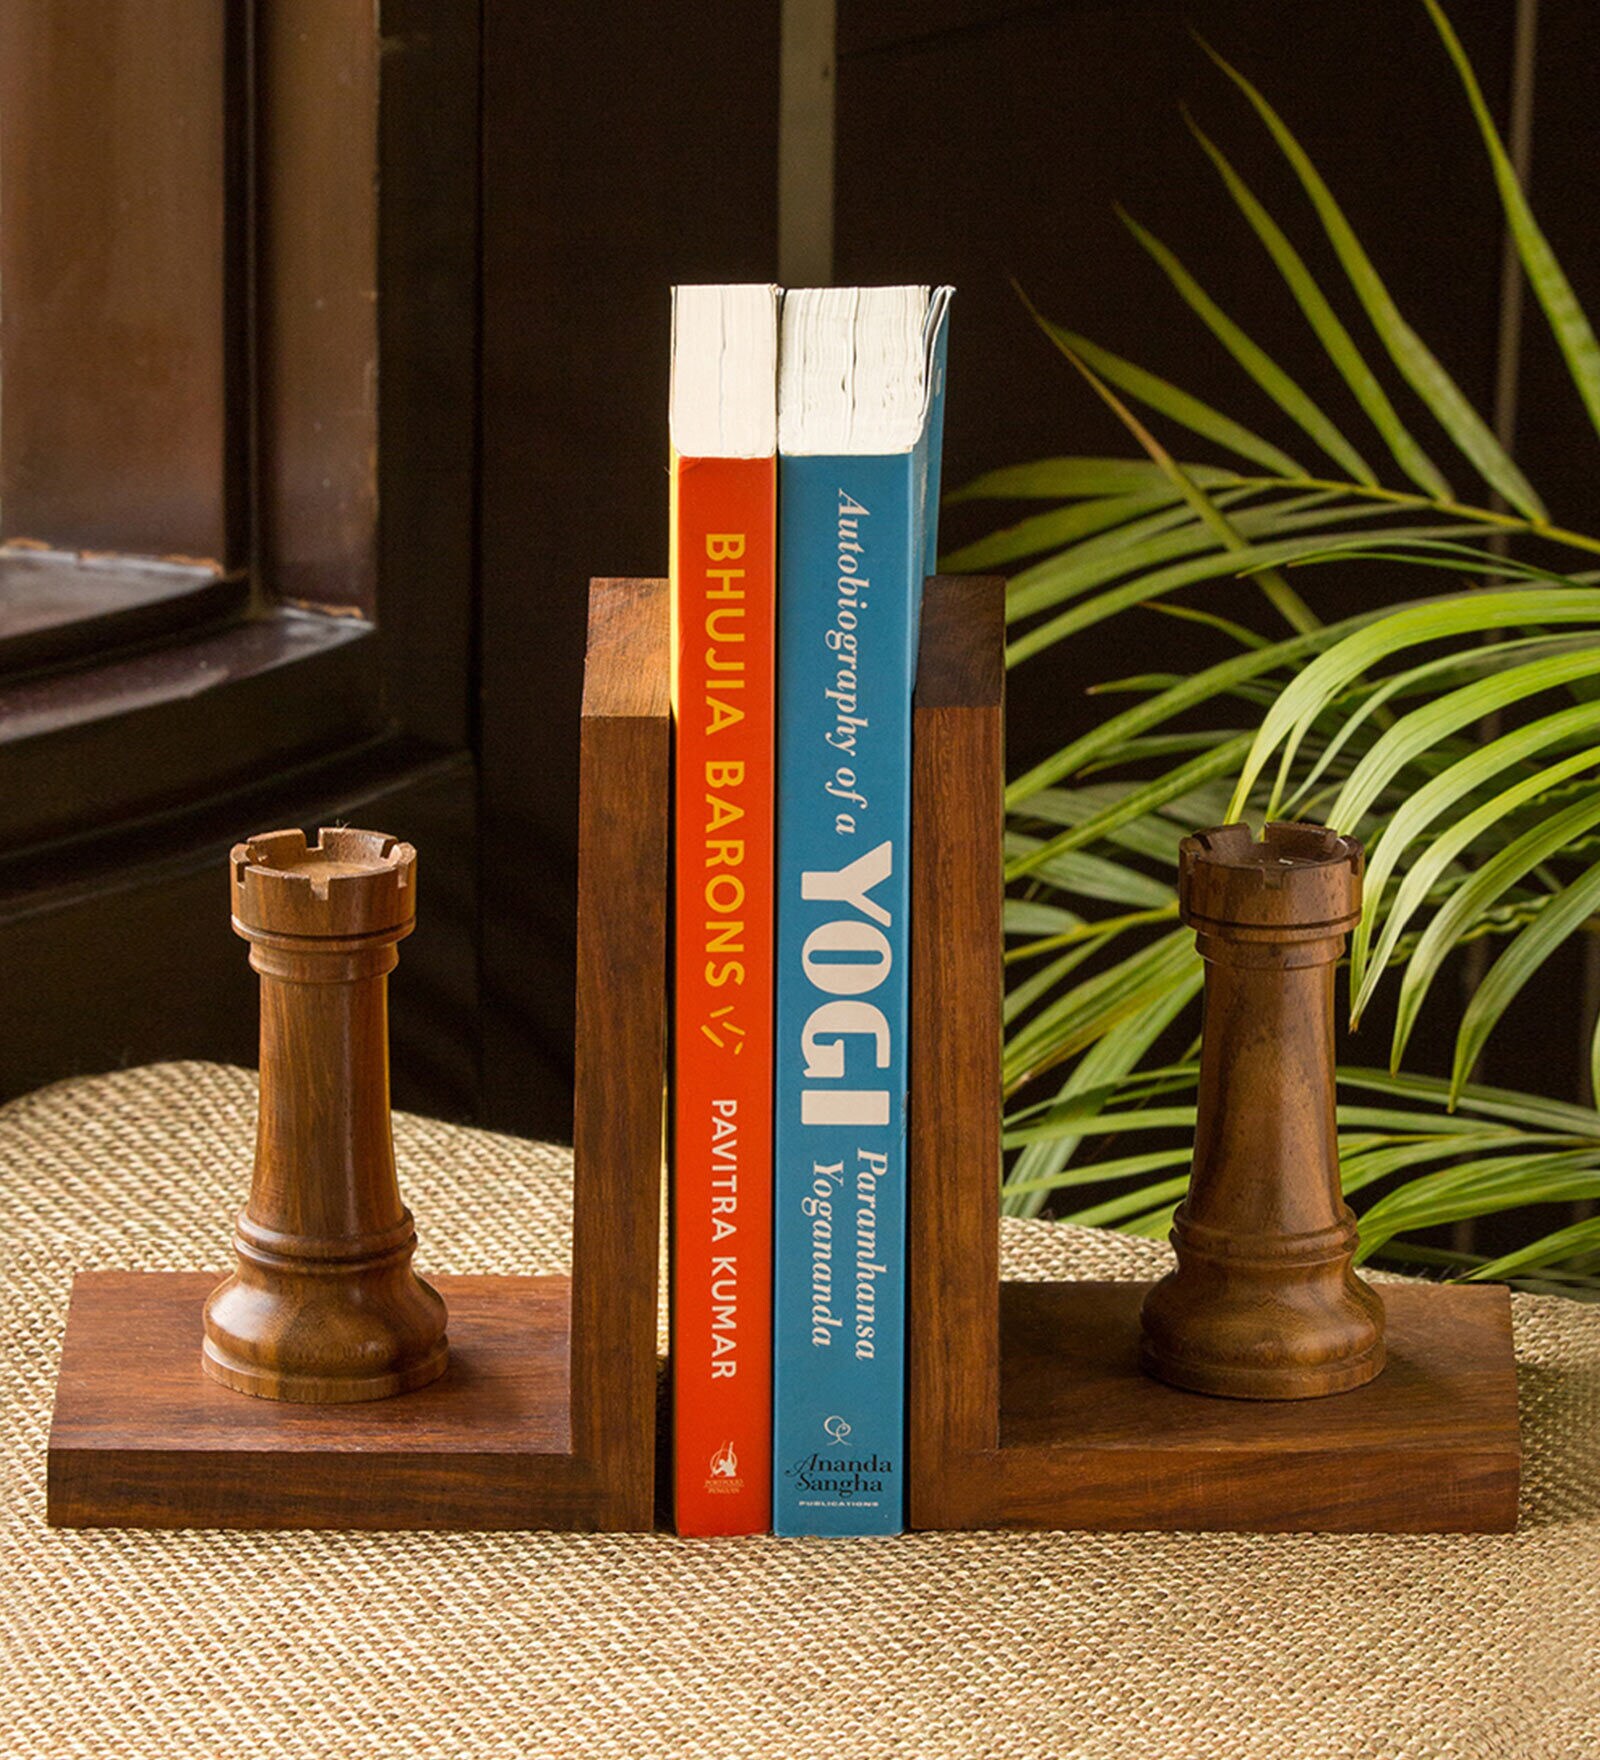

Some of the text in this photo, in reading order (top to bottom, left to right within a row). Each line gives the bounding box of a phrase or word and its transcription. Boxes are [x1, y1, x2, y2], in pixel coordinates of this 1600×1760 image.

[704, 533, 746, 988] BHUJIA BARONS
[800, 487, 893, 1126] Autobiography of a YOGI
[711, 1099, 738, 1379] PAVITRA KUMAR
[801, 1161, 845, 1347] Yogananda
[855, 1148, 888, 1361] Paramhansa
[785, 1453, 893, 1475] Ananda
[796, 1473, 883, 1498] Sangha
[798, 1500, 879, 1508] PUBLICATIONS
